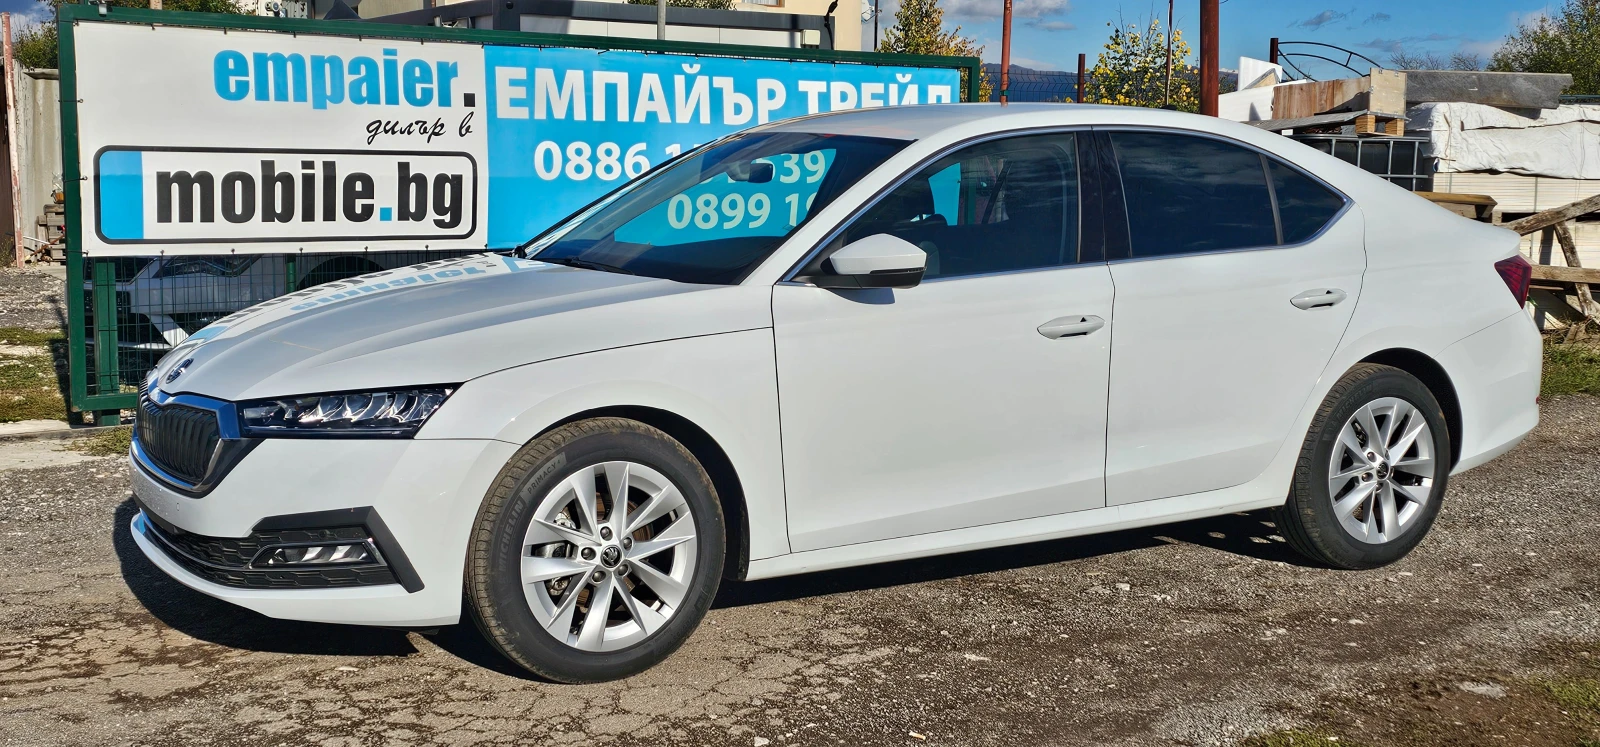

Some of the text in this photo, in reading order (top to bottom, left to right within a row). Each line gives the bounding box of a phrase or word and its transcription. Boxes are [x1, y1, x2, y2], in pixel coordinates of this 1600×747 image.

[494, 64, 788, 125] ЕМПАЙЪР
[365, 117, 447, 146] дилър
[533, 140, 651, 182] 0886
[156, 159, 463, 230] mobile.bg
[667, 192, 771, 230] 0899
[498, 500, 525, 573] MICHELIN
[526, 463, 557, 495] PRIMACY
